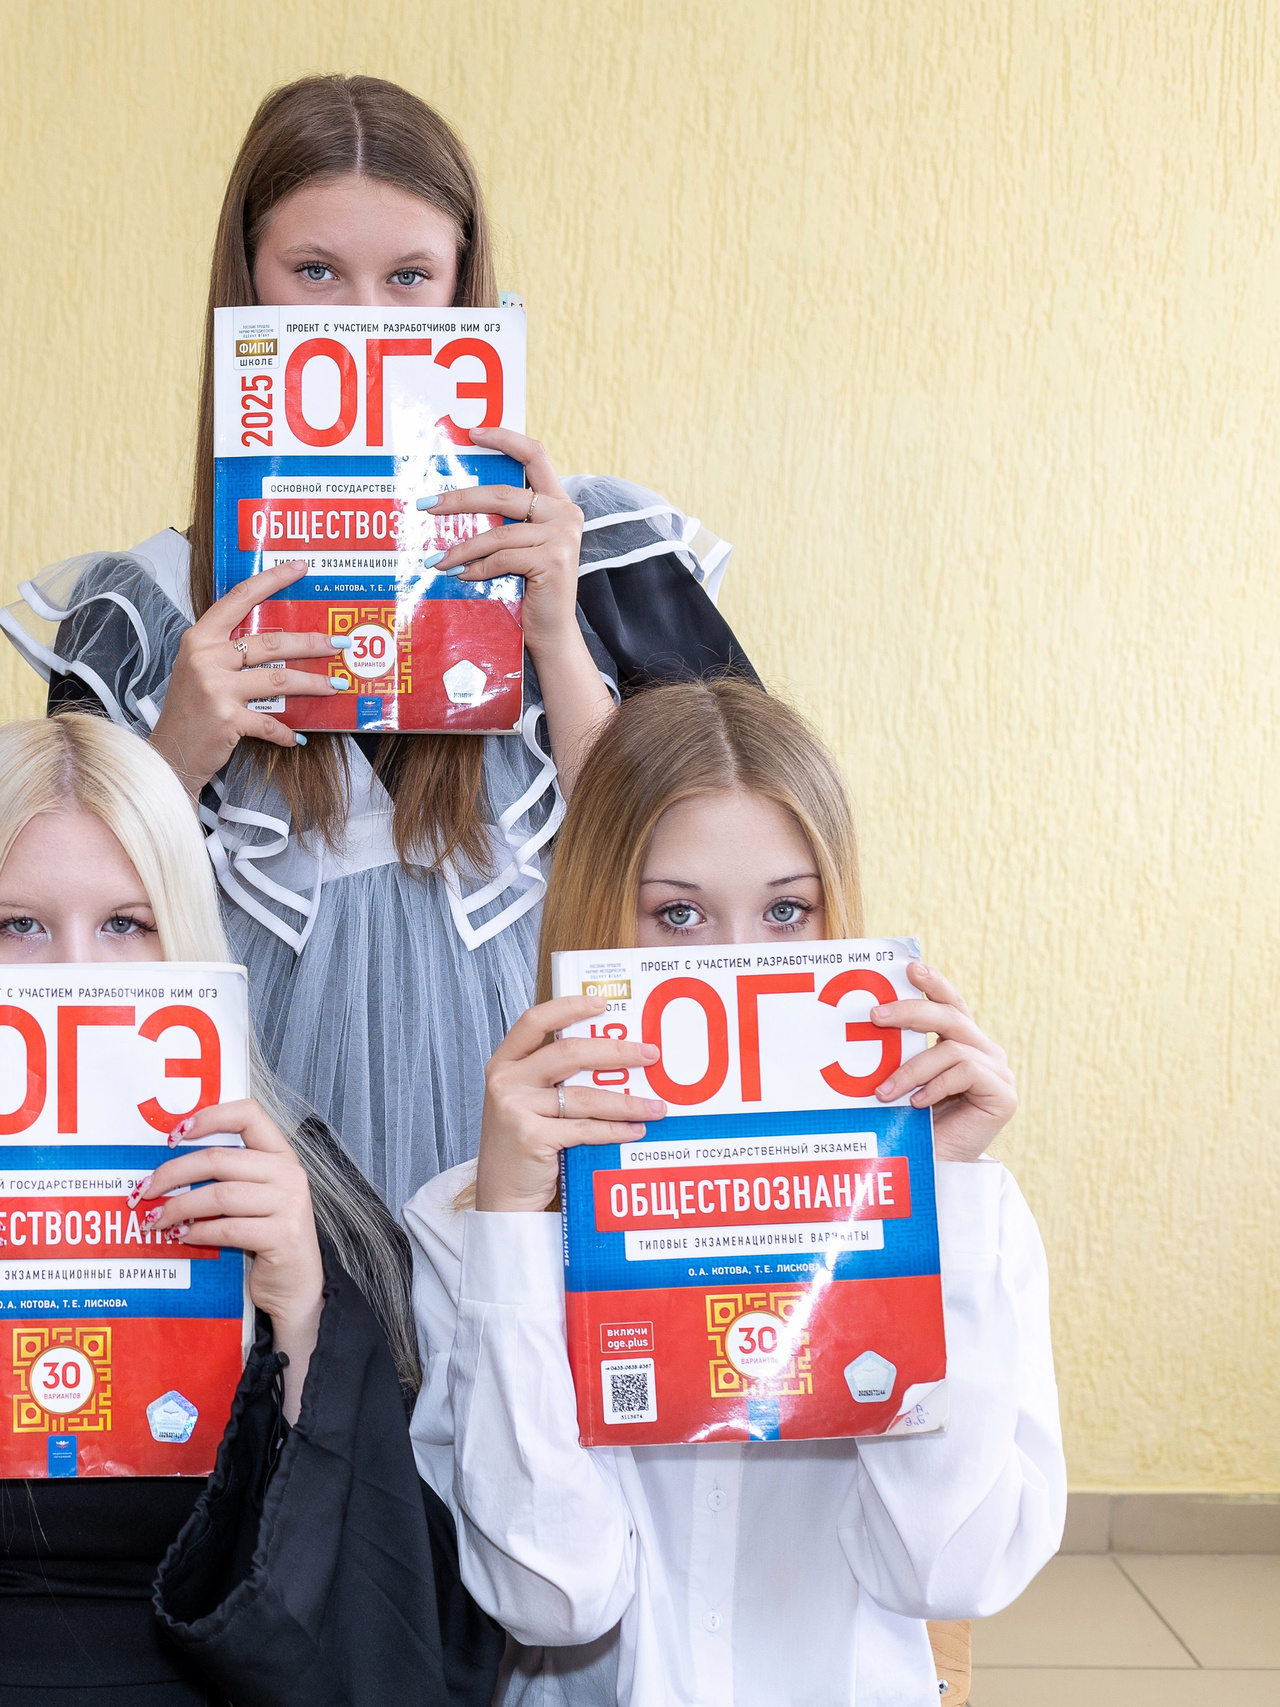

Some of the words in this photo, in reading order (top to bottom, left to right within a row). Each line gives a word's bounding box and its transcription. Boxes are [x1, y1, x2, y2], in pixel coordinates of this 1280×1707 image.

[286, 323, 319, 332] ПРОЕКТ
[324, 323, 329, 332] С
[334, 323, 379, 332] УЧАСТИЕМ
[383, 323, 456, 332] РАЗРАБОТЧИКОВ
[461, 324, 480, 332] КИМ
[484, 323, 500, 332] ОГЭ
[239, 340, 274, 355] ФИПИ
[240, 358, 272, 367] ШКОЛЕ
[284, 337, 503, 447] ОГЭ
[241, 375, 273, 447] 2025
[271, 483, 321, 493] ОСНОВНОЙ
[335, 584, 367, 592] КОТОВА,
[353, 636, 385, 659] 30
[641, 960, 679, 971] ПРОЕКТ
[685, 960, 691, 970] С
[696, 958, 751, 969] УЧАСТИЕМ
[757, 953, 842, 967] РАЗРАБОТЧИКОВ
[848, 953, 870, 962] КИМ
[876, 951, 894, 961] ОГЭ
[7, 988, 13, 998] С
[19, 988, 72, 998] УЧАСТИЕМ
[79, 988, 164, 998] РАЗРАБОТЧИКОВ
[171, 989, 193, 998] КИМ
[199, 988, 217, 998] ОГЭ
[586, 983, 628, 997] ФИПИ
[605, 1003, 627, 1012] ОЛЕ
[641, 969, 902, 1105] ОГЭ
[631, 1148, 690, 1162] ОСНОВНОЙ
[696, 1143, 808, 1159] ГОСУДАРСТВЕННЫЙ
[814, 1142, 866, 1153] ЭКЗАМЕН
[10, 1178, 122, 1190] ГОСУДАРСТВЕННЫЙ
[610, 1171, 895, 1220] ОБЩЕСТВОЗНАНИЕ
[639, 1238, 687, 1250] ТИПОВЫЕ
[695, 1233, 803, 1248] ЭКЗАМЕНАЦИОННЫЕ
[5, 1269, 112, 1280] ЭКЗАМЕНАЦИОННЫЕ
[119, 1269, 176, 1279] ВАРИАНТЫ
[712, 1266, 751, 1275] КОТОВА,
[20, 1300, 59, 1309] КОТОВА,
[84, 1299, 128, 1308] ЛИСКОВА
[607, 1328, 647, 1337] включи
[608, 1337, 648, 1351] oge.plus
[739, 1326, 778, 1355] 30
[43, 1361, 80, 1389] 30
[44, 1392, 81, 1400] ВАРИАНТОВ
